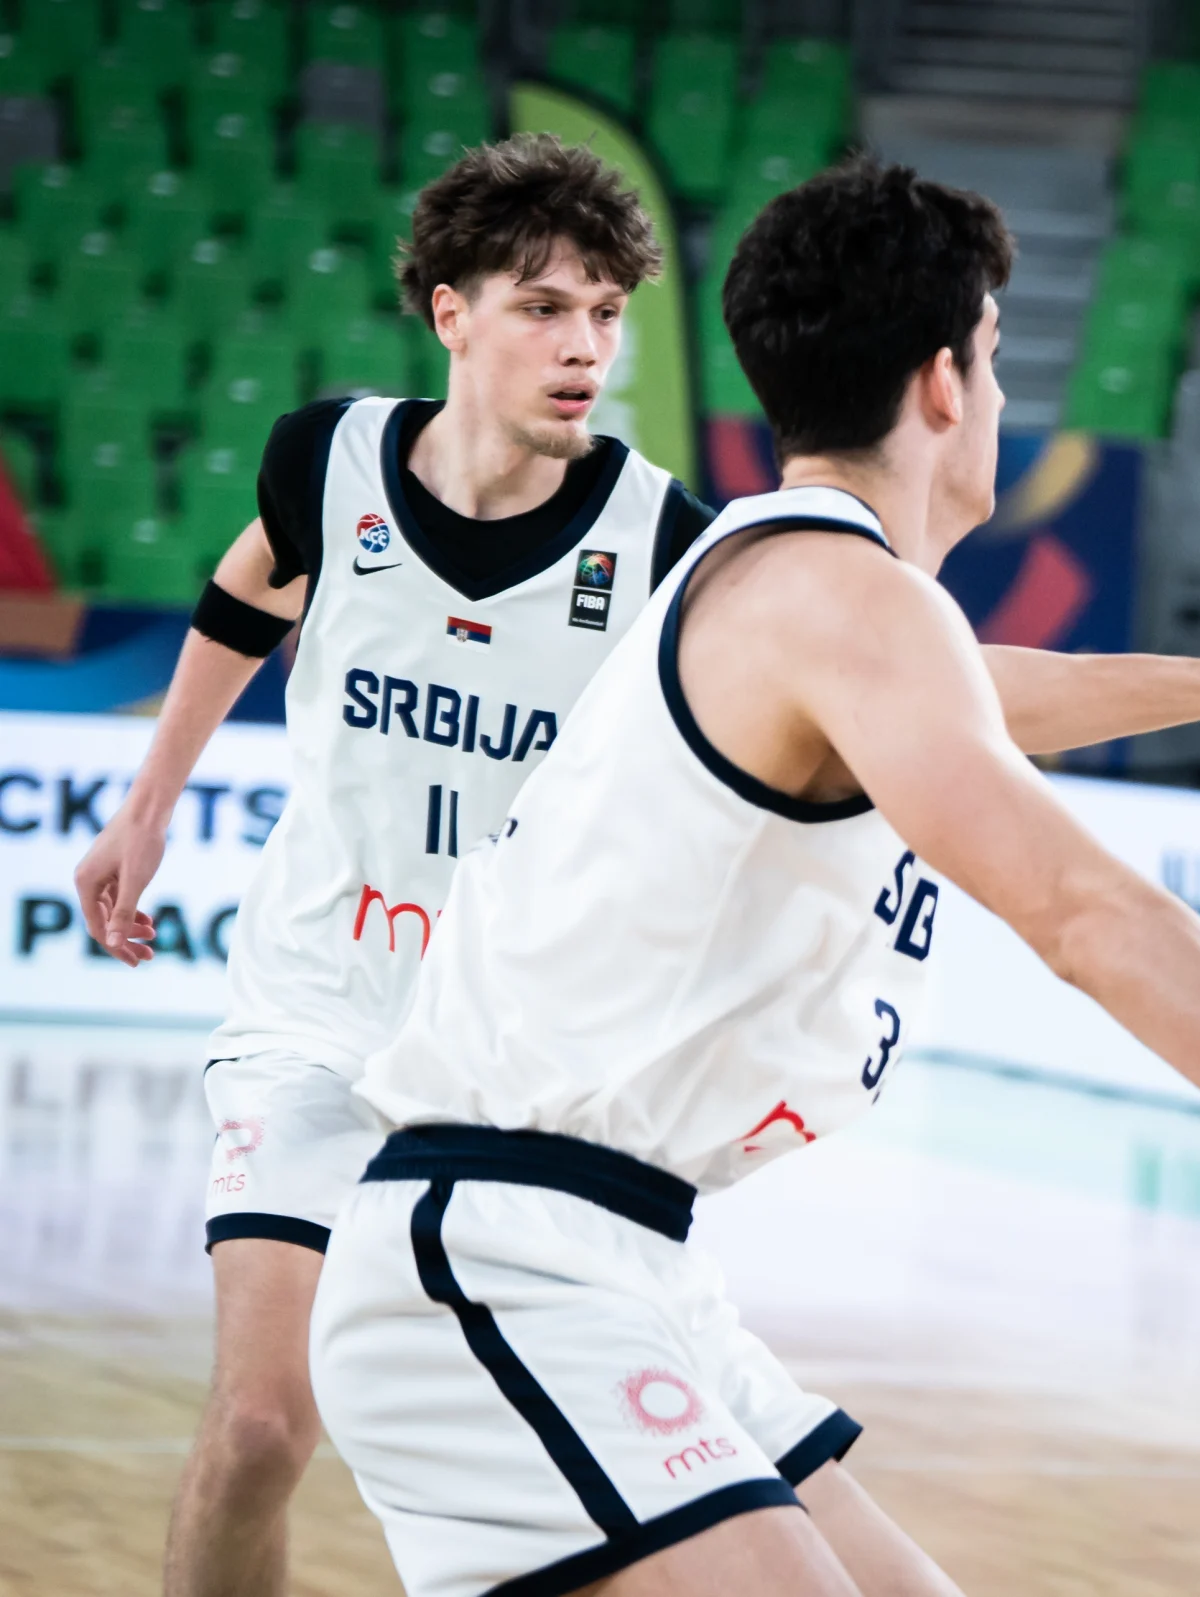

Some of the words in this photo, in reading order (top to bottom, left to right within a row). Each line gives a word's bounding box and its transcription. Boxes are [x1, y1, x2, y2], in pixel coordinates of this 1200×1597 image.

[576, 593, 606, 611] FIBA
[342, 667, 559, 763] SRBIJA
[0, 772, 288, 850] CKTS
[424, 784, 459, 858] 11
[861, 998, 901, 1091] 3
[663, 1437, 738, 1479] mts
